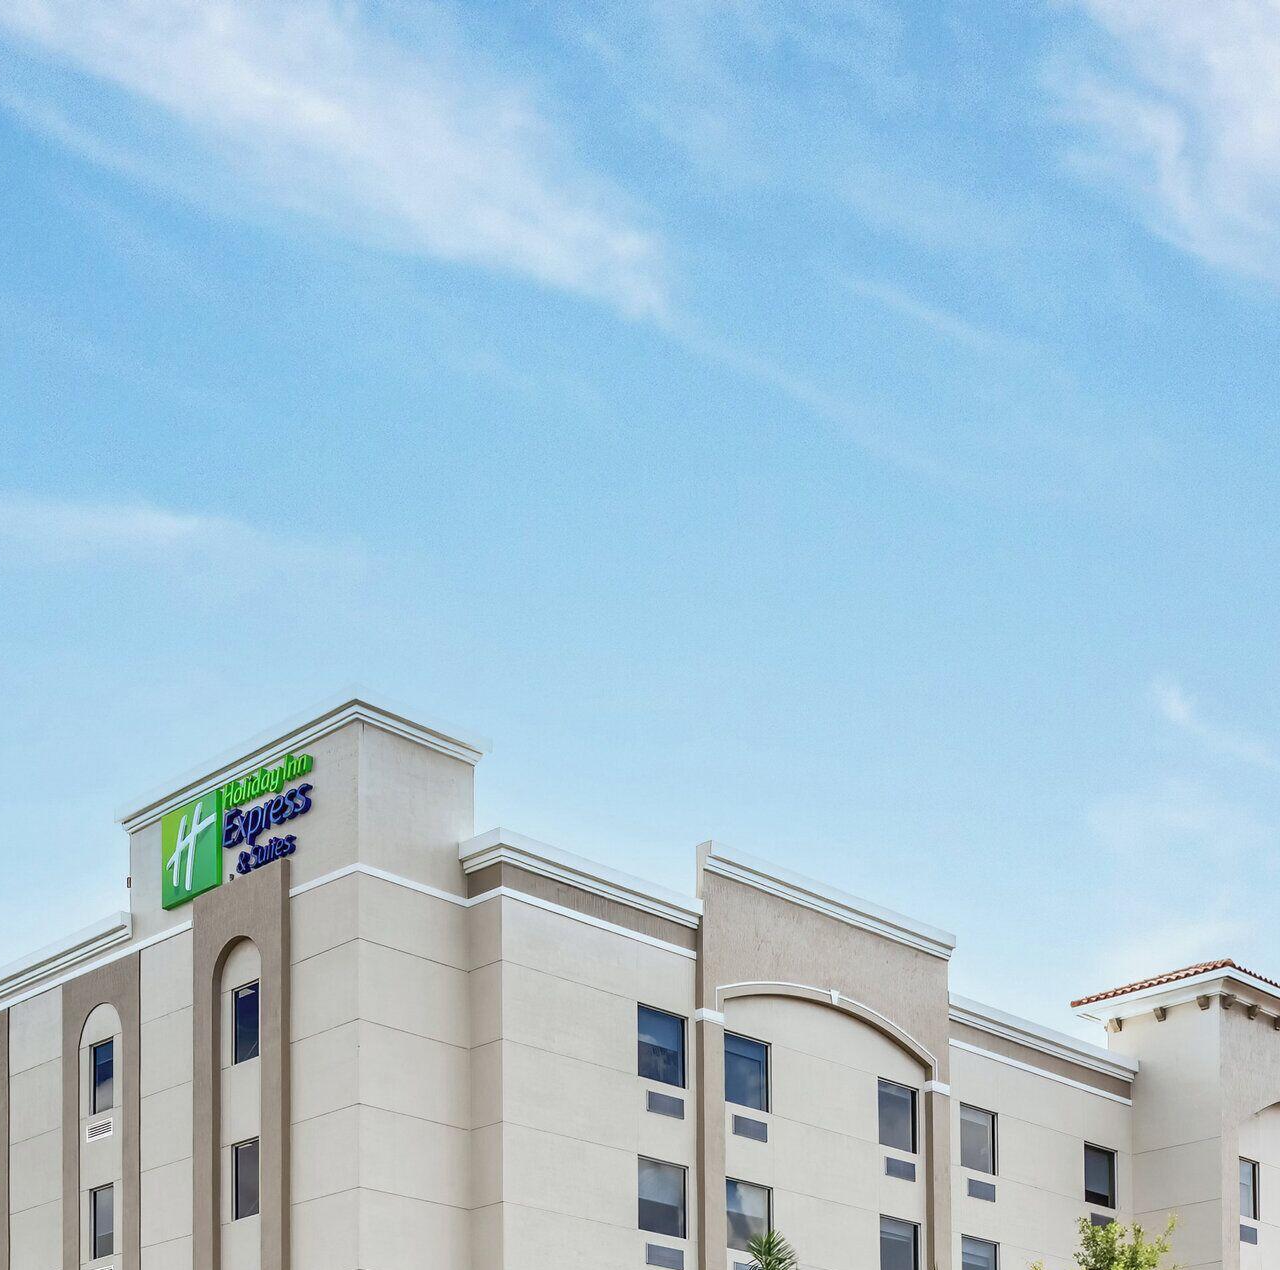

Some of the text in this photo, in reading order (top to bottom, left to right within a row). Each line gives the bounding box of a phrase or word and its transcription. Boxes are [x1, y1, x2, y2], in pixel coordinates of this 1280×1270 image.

[222, 754, 312, 808] Holiday Inn
[222, 783, 313, 848] Express
[236, 835, 297, 874] & Suites
